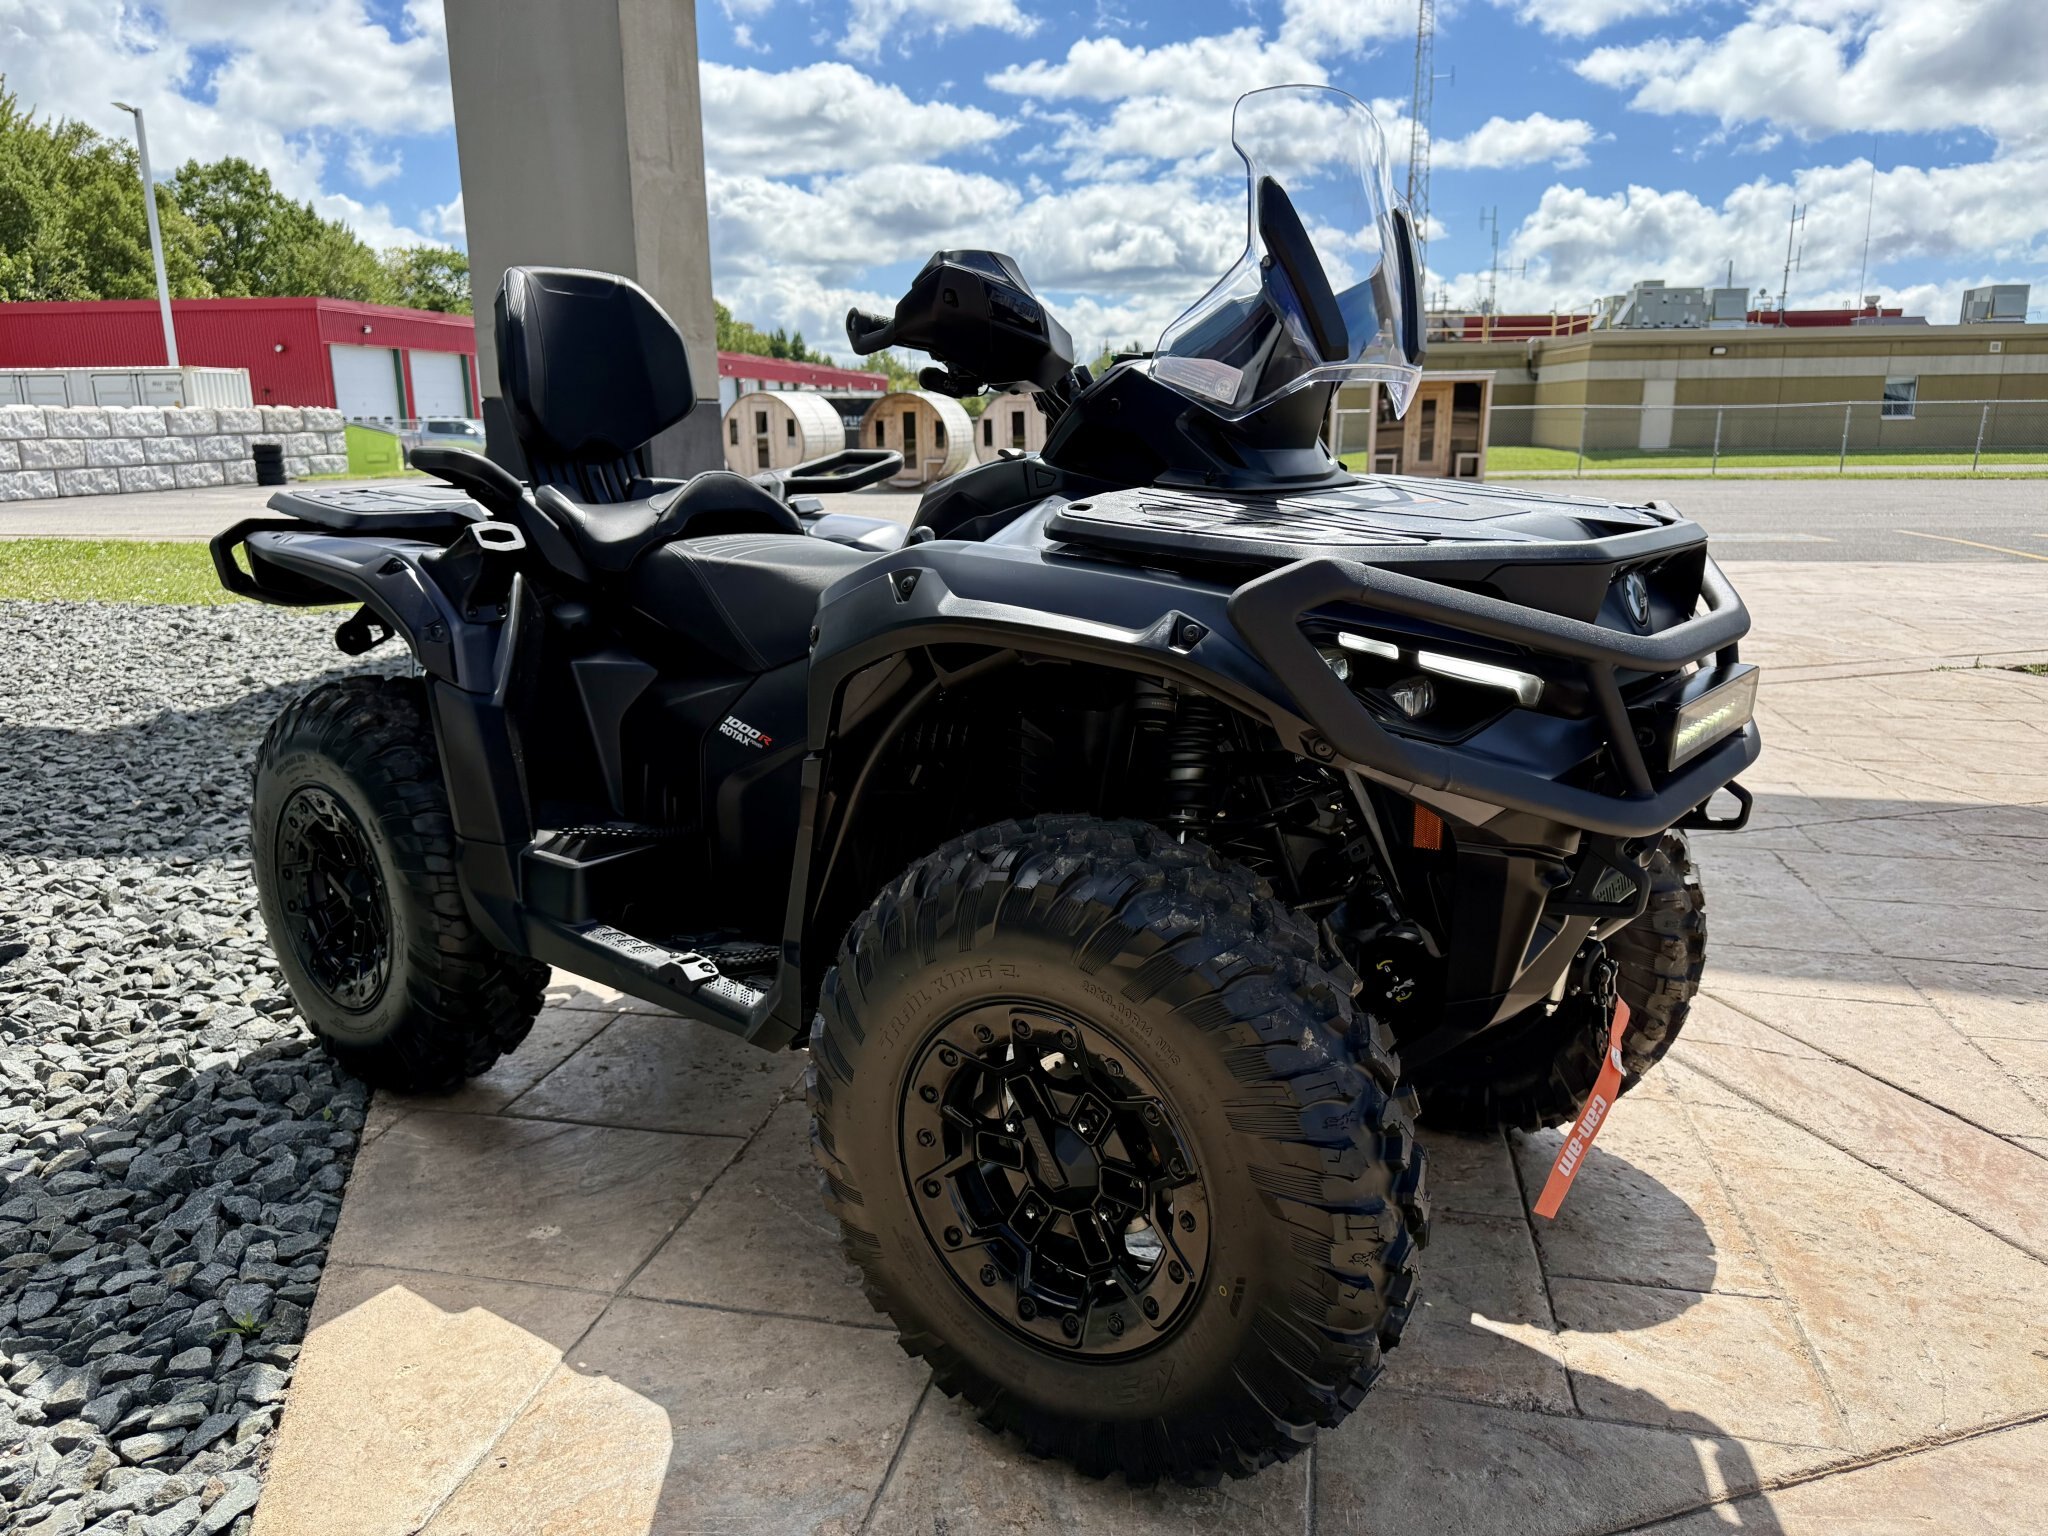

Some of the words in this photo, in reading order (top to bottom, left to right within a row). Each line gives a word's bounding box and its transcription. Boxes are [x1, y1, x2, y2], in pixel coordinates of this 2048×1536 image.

[719, 723, 751, 746] ROTAX
[725, 715, 772, 746] 1000R
[880, 989, 932, 1049] TRAIL
[931, 965, 993, 995] KING
[1557, 1094, 1607, 1177] can-am
